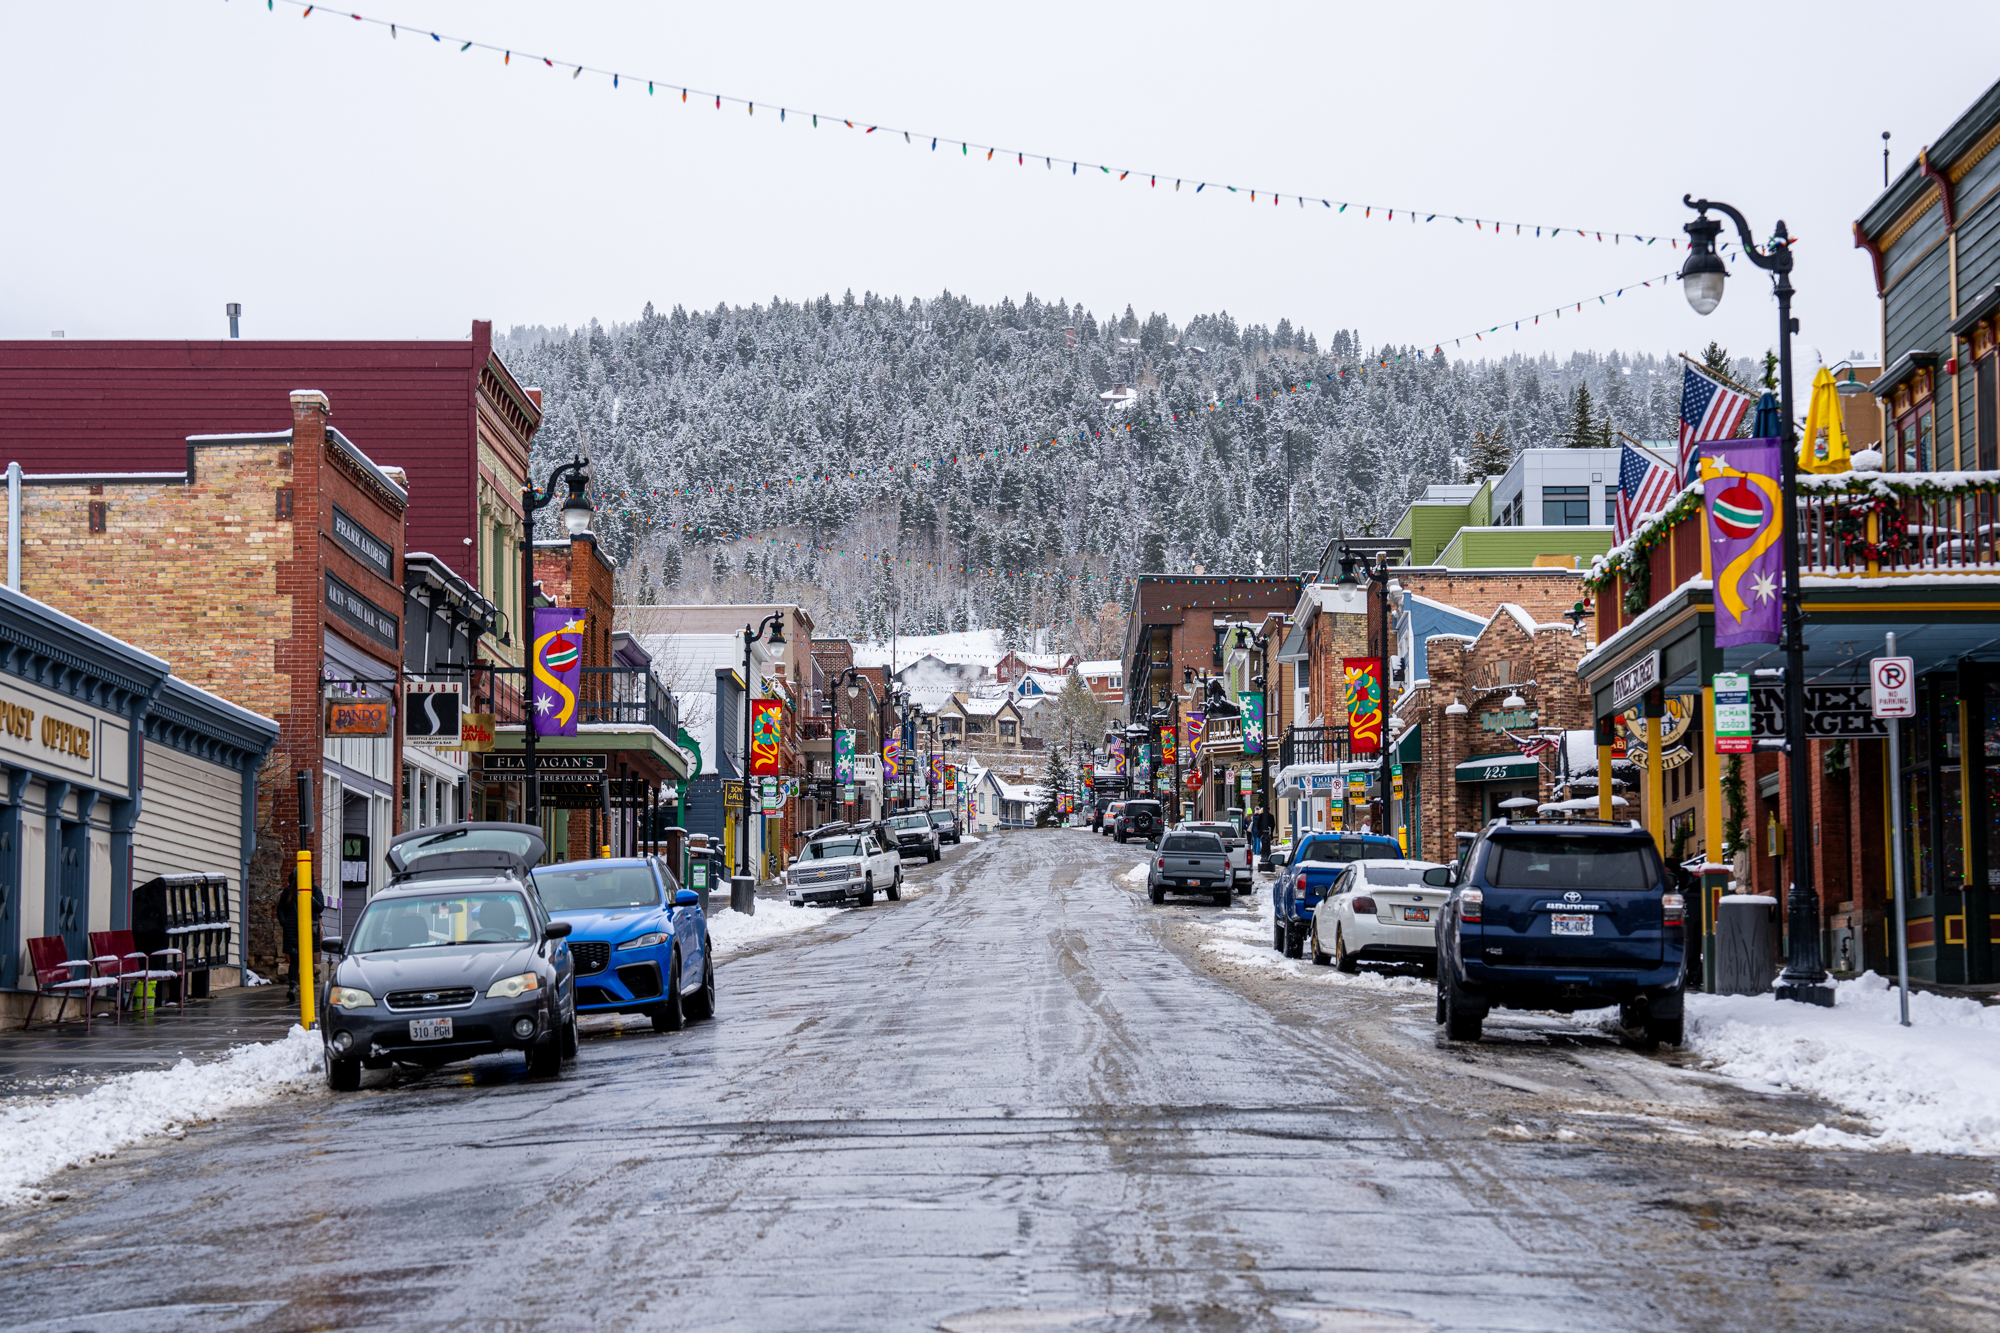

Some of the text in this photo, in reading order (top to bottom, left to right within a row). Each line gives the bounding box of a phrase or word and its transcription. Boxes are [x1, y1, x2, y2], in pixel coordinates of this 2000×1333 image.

[335, 517, 389, 570] FRANK ANDREW
[406, 684, 459, 692] SHABU
[338, 709, 382, 721] PANDO
[0, 699, 90, 760] POST OFFICE
[497, 757, 594, 768] FLAAGAN'S
[1483, 766, 1508, 779] 425
[413, 1025, 450, 1038] 310 PGH
